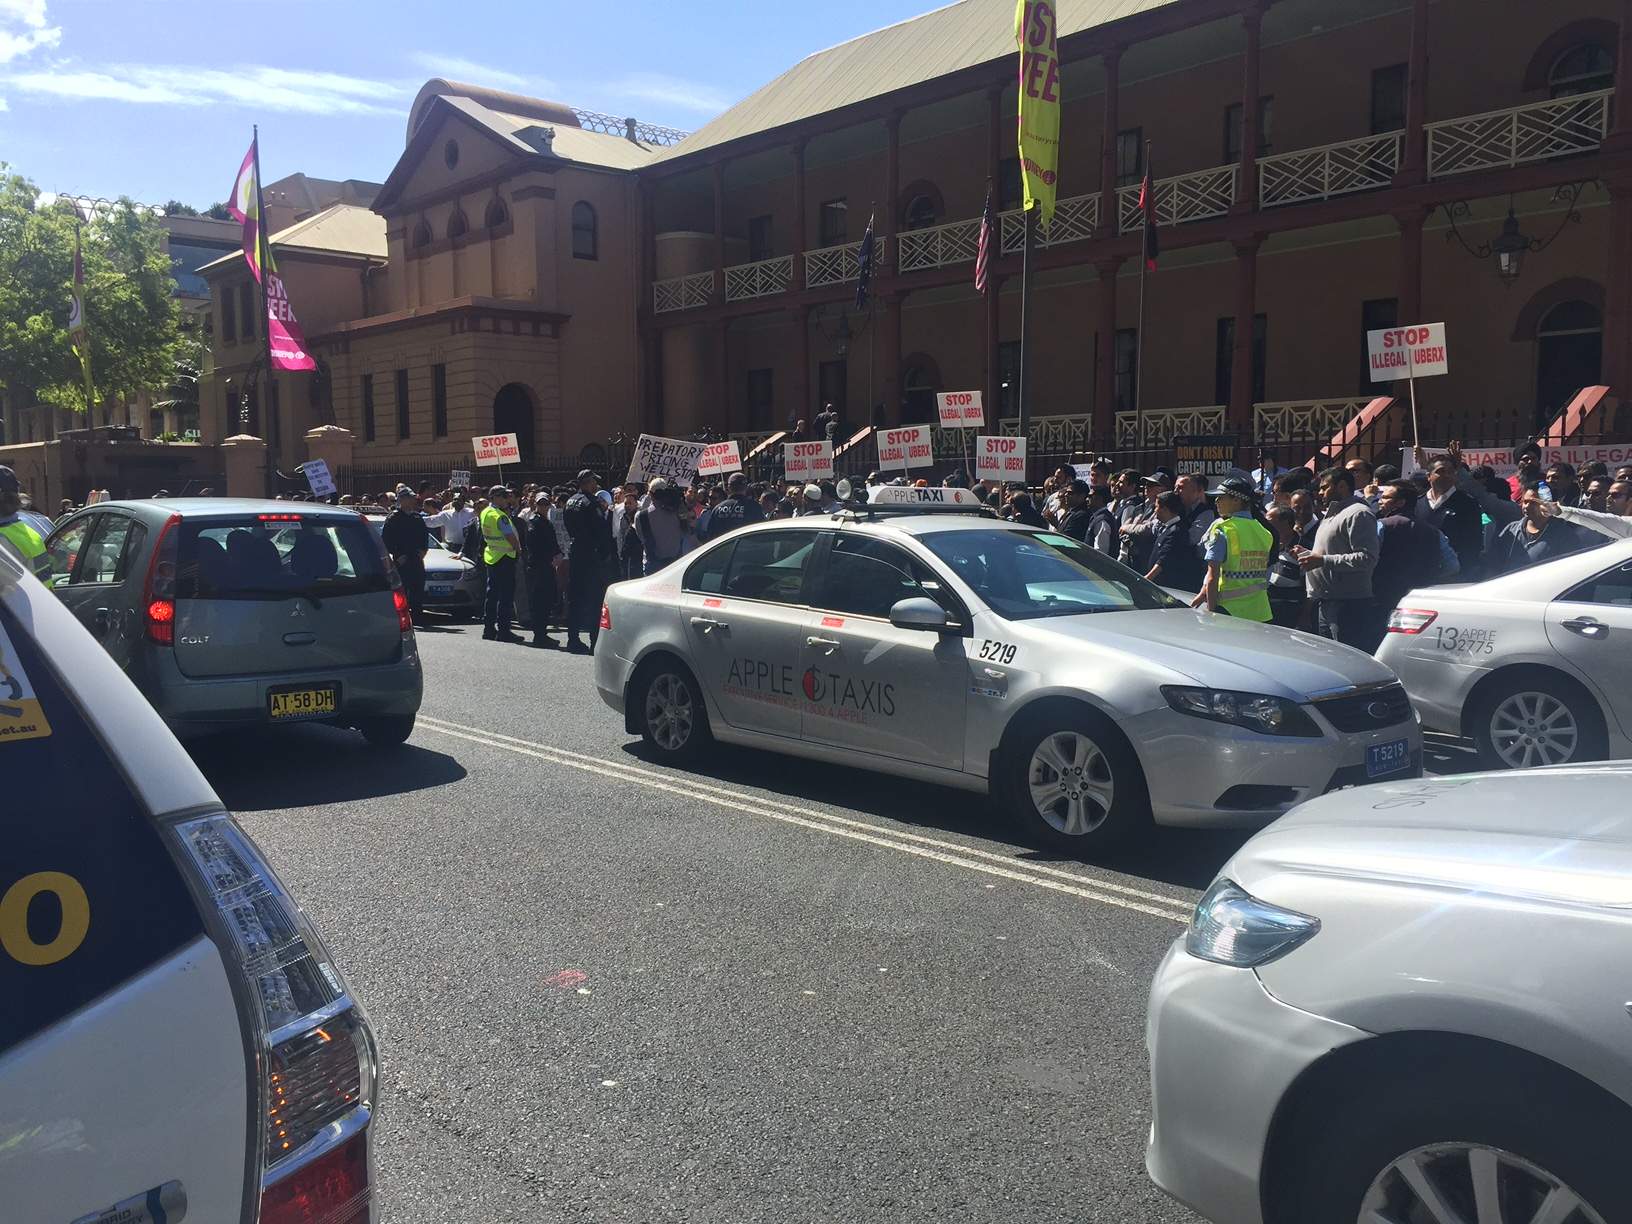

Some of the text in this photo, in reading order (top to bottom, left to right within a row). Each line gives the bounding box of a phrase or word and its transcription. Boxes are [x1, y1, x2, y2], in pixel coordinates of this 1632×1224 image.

[1383, 327, 1430, 348] STOP
[1371, 346, 1445, 369] ILLEGAL UBERX
[945, 393, 973, 406] STOP
[940, 408, 982, 420] ILLEGAL UBERX
[482, 436, 508, 448] STOP
[887, 429, 920, 446] STOP
[475, 446, 518, 460] ILLEGAL UBERX
[638, 438, 704, 460] PREDATORY
[704, 444, 730, 457] STOP
[793, 443, 822, 457] STOP
[880, 444, 930, 461] ILLEGAL UBERX
[986, 439, 1016, 453] STOP
[1203, 446, 1224, 460] RISK
[1225, 446, 1235, 460] IT
[640, 450, 689, 468] PRICING
[721, 454, 740, 466] UBERX
[786, 458, 832, 472] ILLEGAL UBERX
[978, 456, 1024, 471] ILLEGAL UBERX
[1545, 451, 1562, 465] IS
[1177, 461, 1206, 475] CATCH
[1207, 461, 1214, 475] A
[914, 488, 944, 502] TAXI
[181, 636, 209, 644] COLT
[1436, 626, 1497, 650] 13 APPLE
[979, 639, 1017, 664] 5219
[1457, 640, 1494, 655] 2775
[728, 658, 896, 717] APPLE TAXIS
